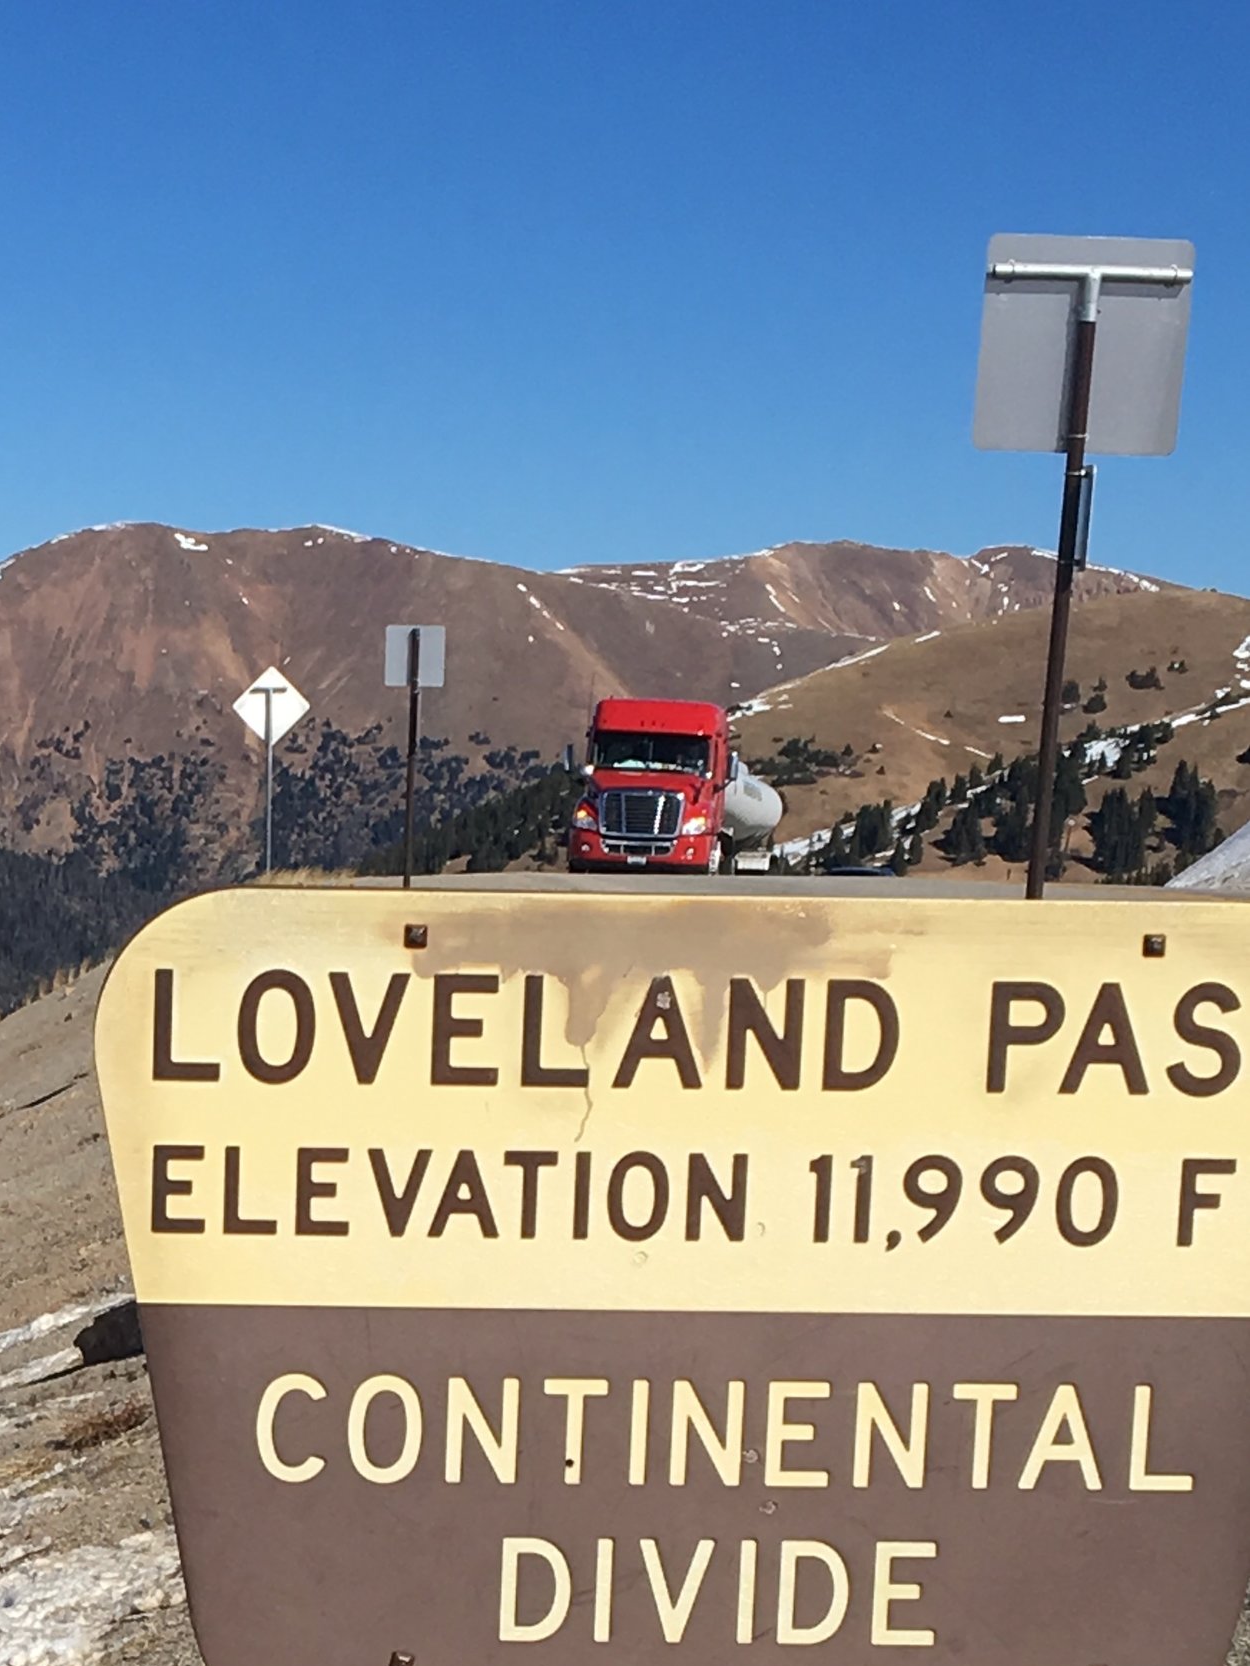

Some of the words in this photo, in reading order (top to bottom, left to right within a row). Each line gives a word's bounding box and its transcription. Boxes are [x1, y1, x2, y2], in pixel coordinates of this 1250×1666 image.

[152, 968, 899, 1091] LOVELAND
[986, 981, 1242, 1097] PAS
[150, 1144, 748, 1242] ELEVATION
[809, 1154, 1118, 1251] 11,990
[1177, 1158, 1237, 1247] F
[256, 1373, 1193, 1491] CONTINENTAL
[498, 1537, 937, 1646] DIVIDE
